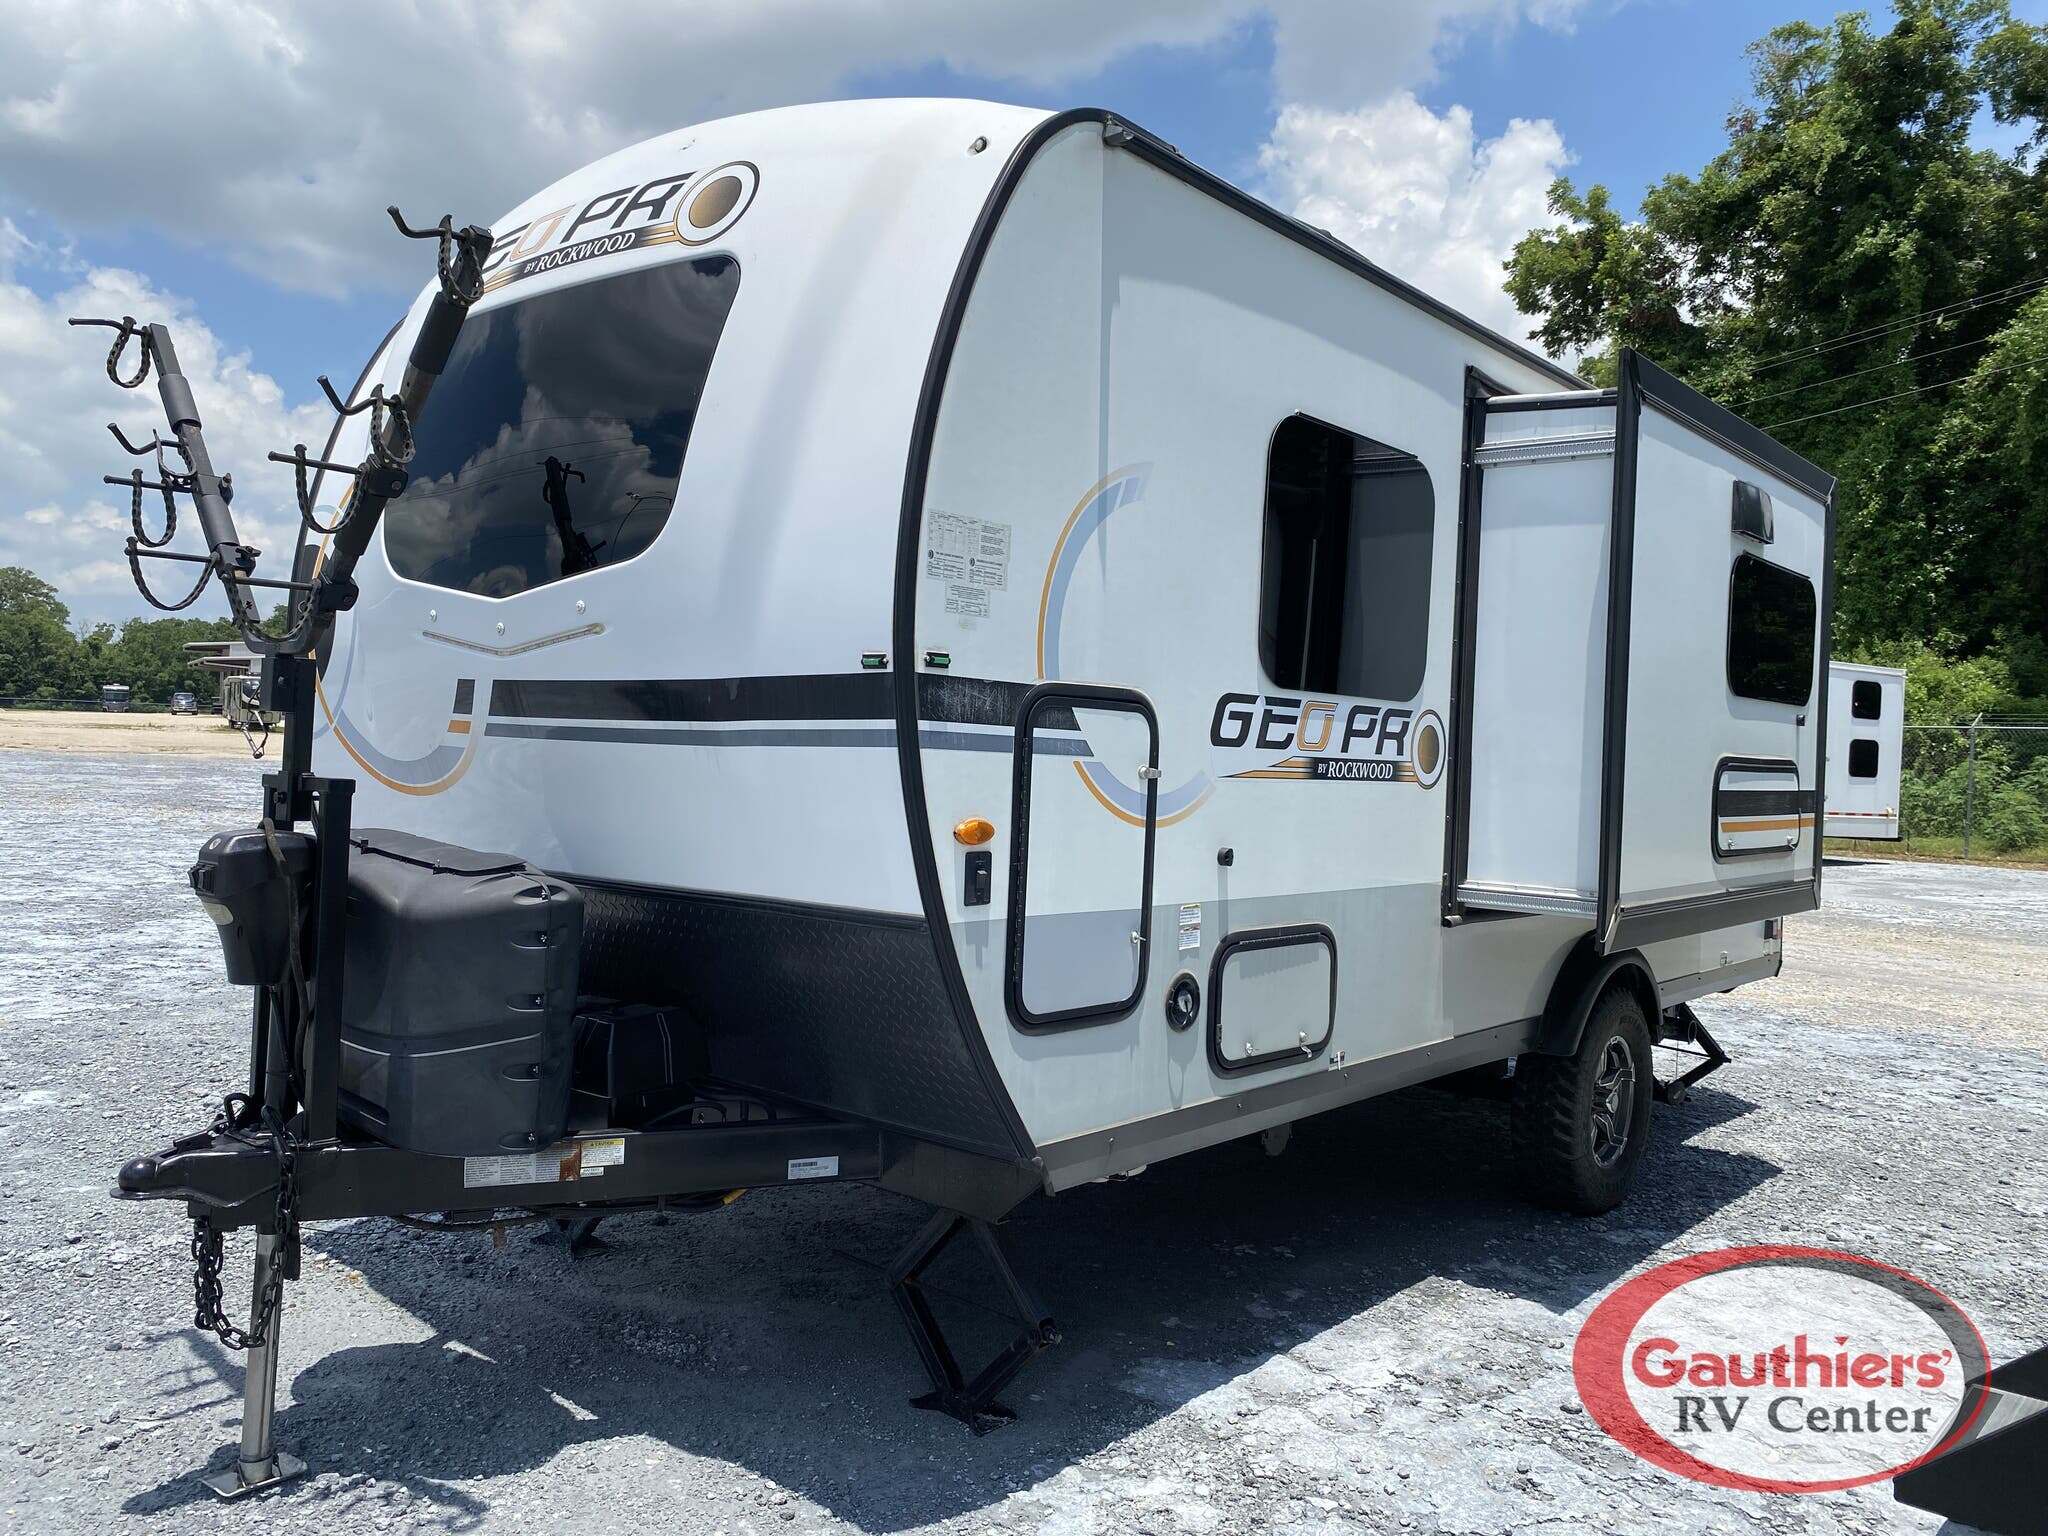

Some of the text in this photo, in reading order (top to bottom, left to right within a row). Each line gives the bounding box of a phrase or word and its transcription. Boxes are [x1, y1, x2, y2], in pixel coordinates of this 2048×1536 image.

[560, 160, 761, 247] PRO
[524, 232, 636, 274] BY ROCKWOOD
[1210, 692, 1447, 790] GEO PRO
[1317, 760, 1394, 780] BY ROCKWOOD
